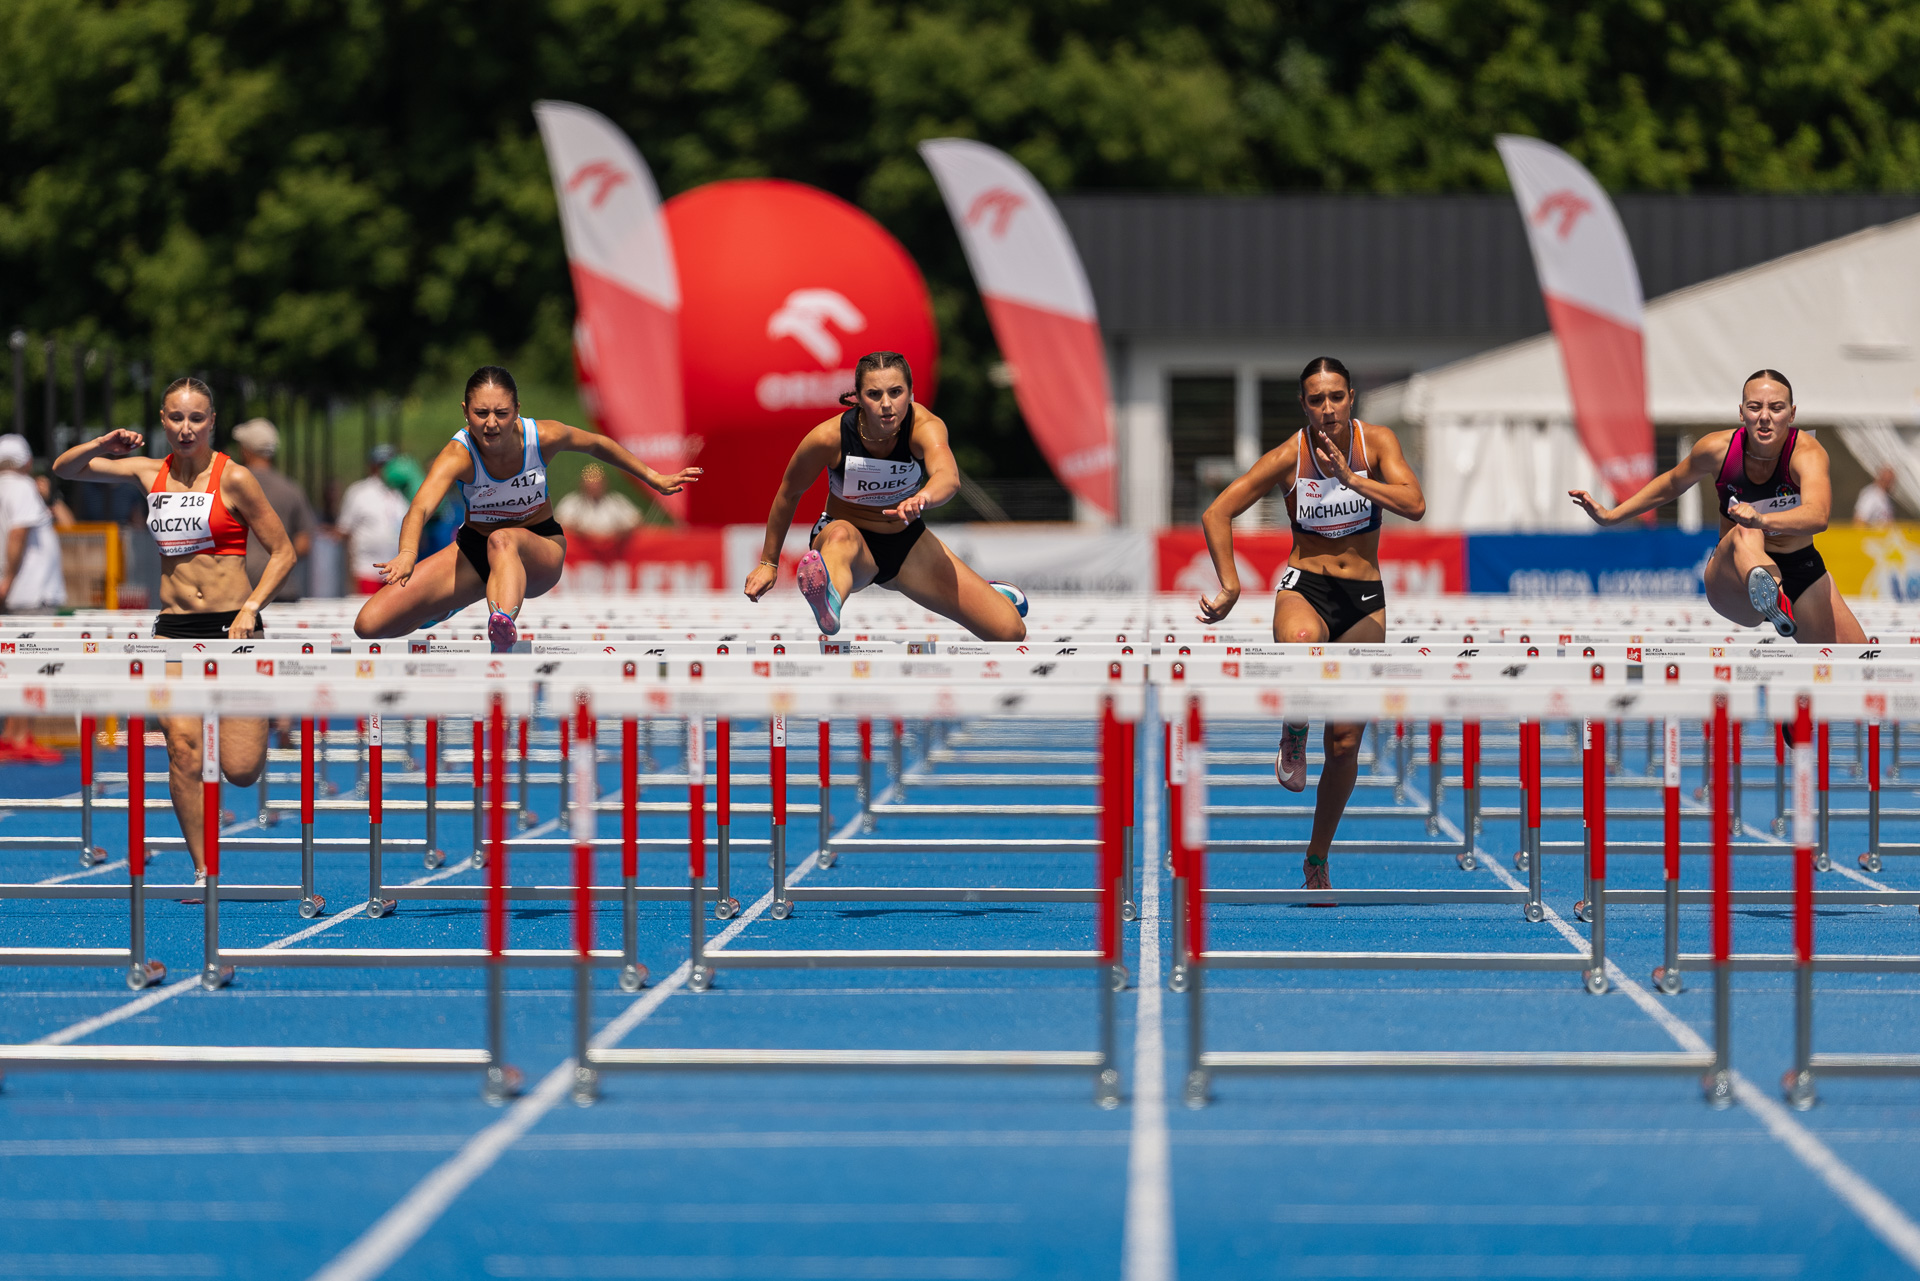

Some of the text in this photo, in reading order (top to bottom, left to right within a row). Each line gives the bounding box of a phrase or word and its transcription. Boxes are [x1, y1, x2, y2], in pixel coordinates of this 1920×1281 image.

[756, 369, 862, 411] ORLE
[511, 472, 537, 488] 417
[857, 478, 908, 491] ROJEK
[180, 496, 205, 507] 218
[472, 490, 543, 509] MRUGAŁA
[1769, 497, 1797, 508] 454
[1299, 498, 1369, 519] MICHALUK
[151, 517, 202, 532] OLCZYK
